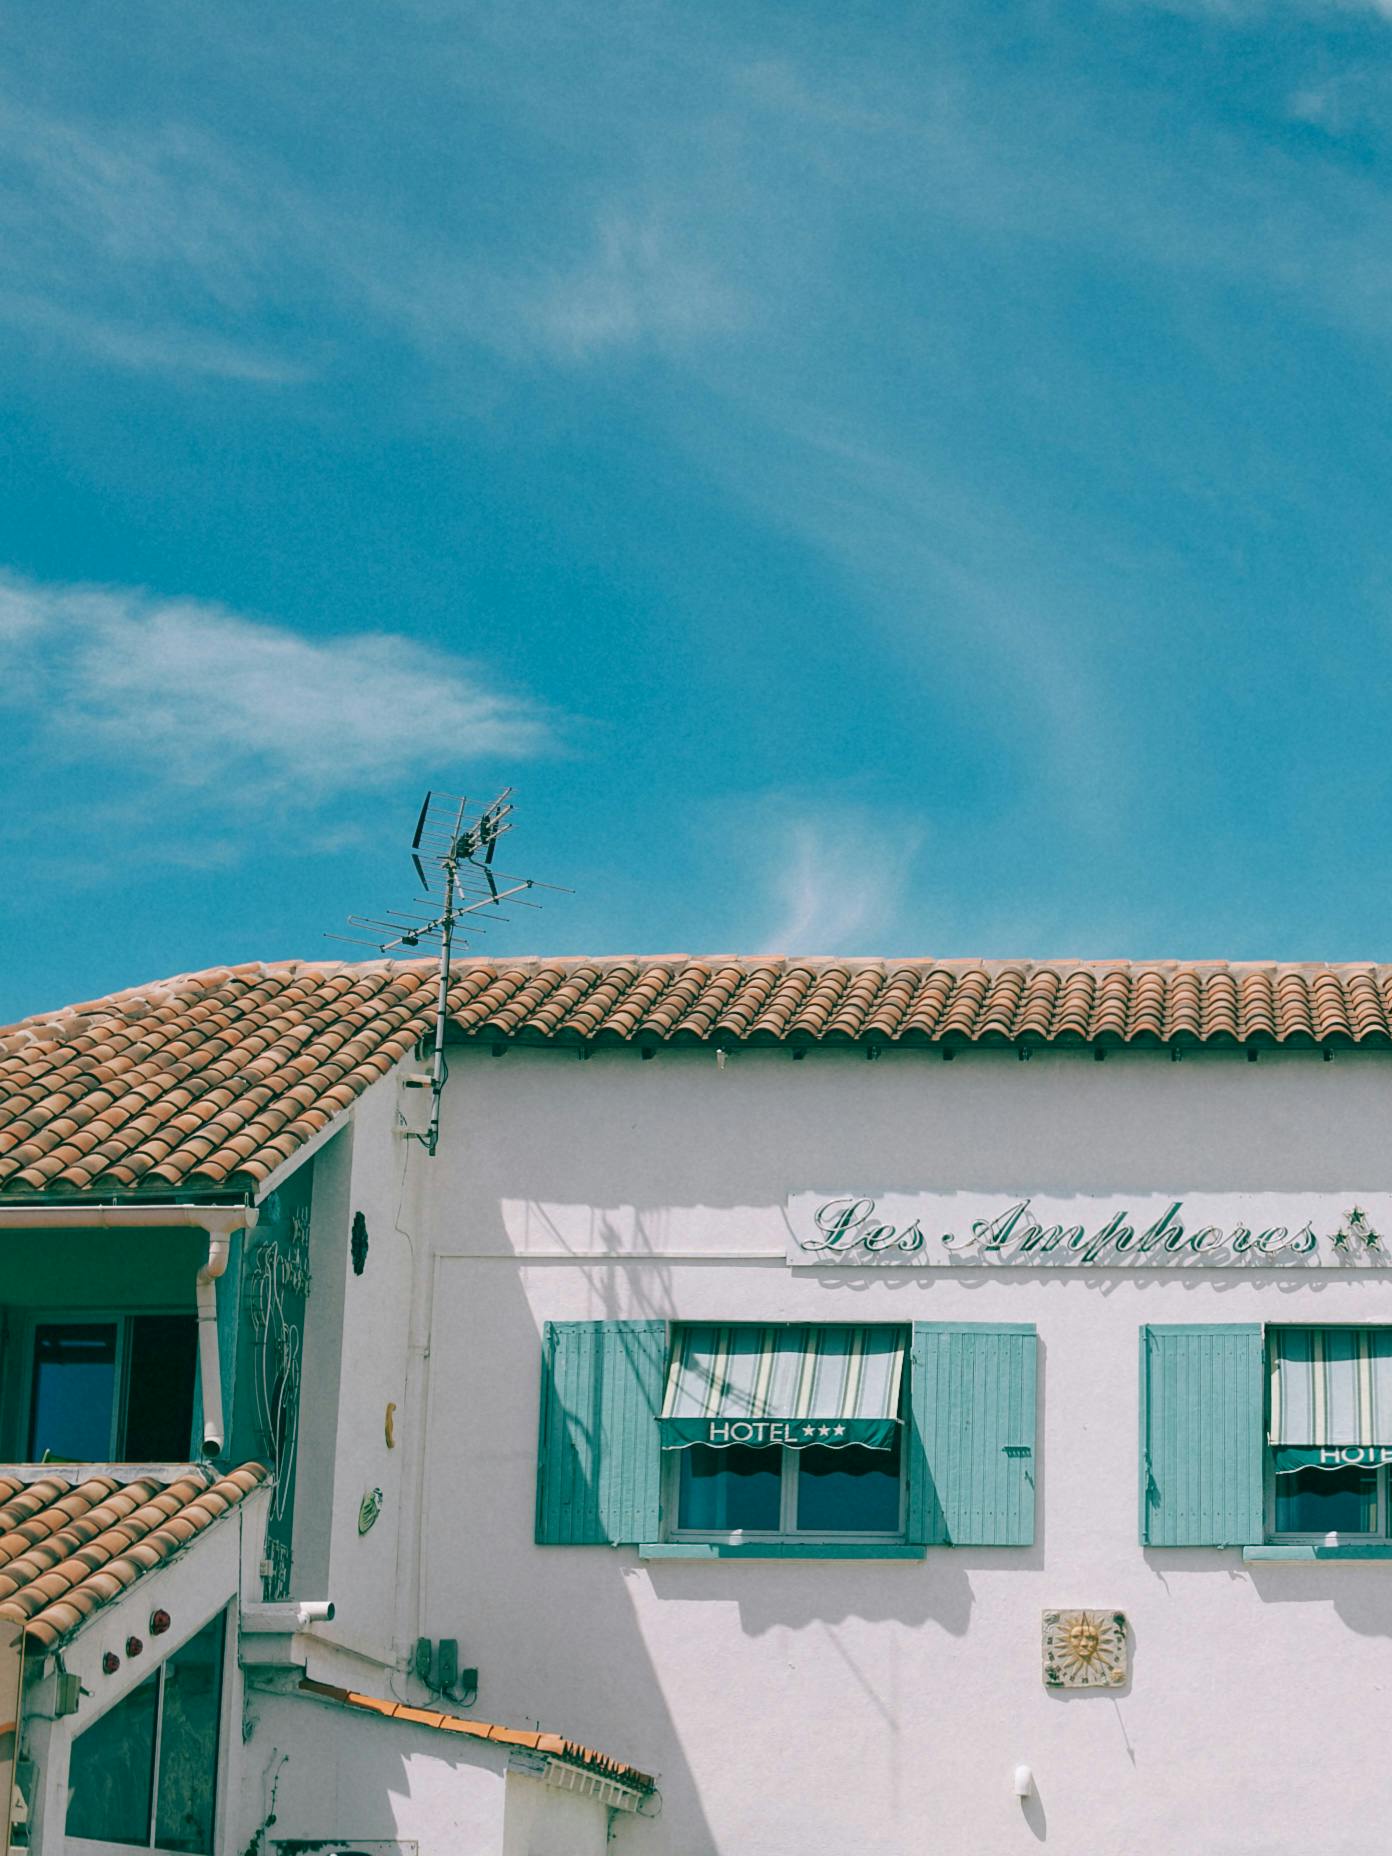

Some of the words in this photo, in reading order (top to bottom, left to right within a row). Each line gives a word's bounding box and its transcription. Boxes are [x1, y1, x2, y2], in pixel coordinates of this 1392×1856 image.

[801, 1198, 925, 1251] Les
[942, 1199, 1317, 1262] Amphores
[709, 1421, 798, 1442] HOTEL
